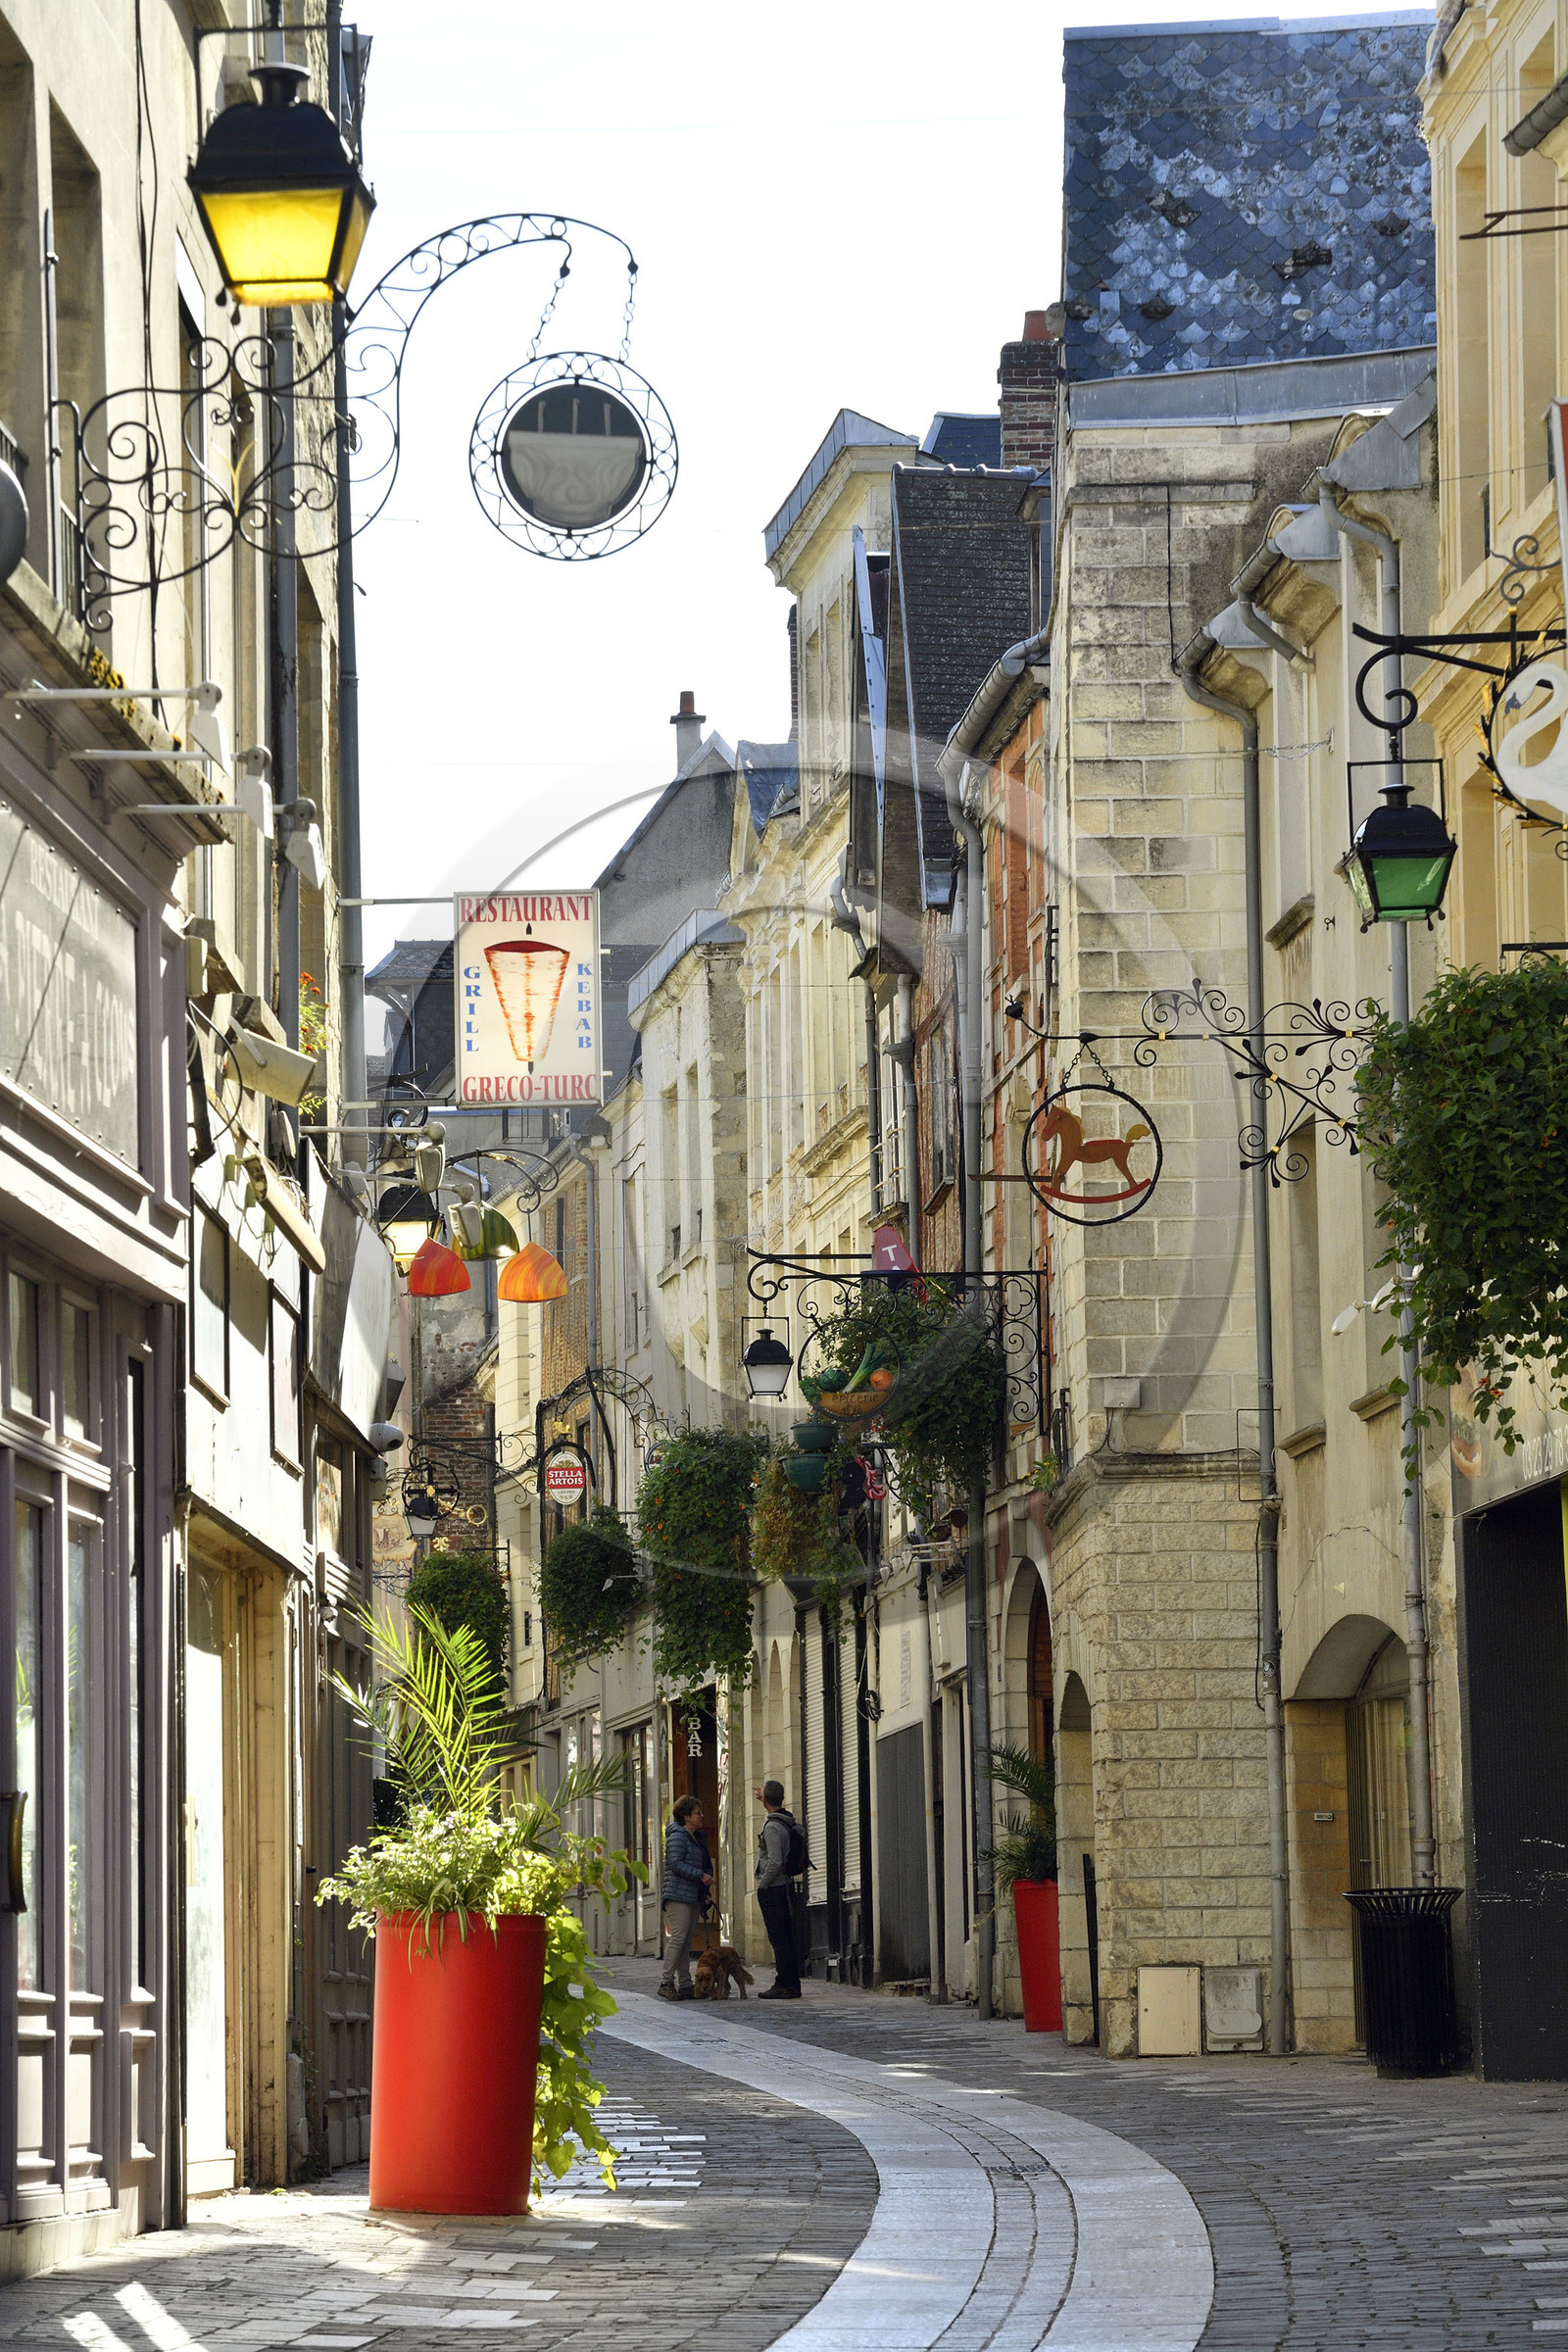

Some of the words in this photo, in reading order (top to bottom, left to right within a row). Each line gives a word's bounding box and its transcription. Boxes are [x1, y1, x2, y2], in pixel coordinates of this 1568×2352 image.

[29, 837, 99, 942] RESTAURANT
[461, 896, 592, 922] RESTAURANT
[16, 909, 75, 1114] PIERRE
[464, 965, 482, 1052] GRILL
[575, 963, 593, 1049] KEBAB
[463, 1073, 596, 1102] GRECO-TURC
[1522, 1441, 1533, 1481] 03
[1533, 1437, 1543, 1477] 23
[1544, 1433, 1553, 1472] 29
[1553, 1427, 1564, 1467] 78
[687, 1717, 703, 1757] BAR
